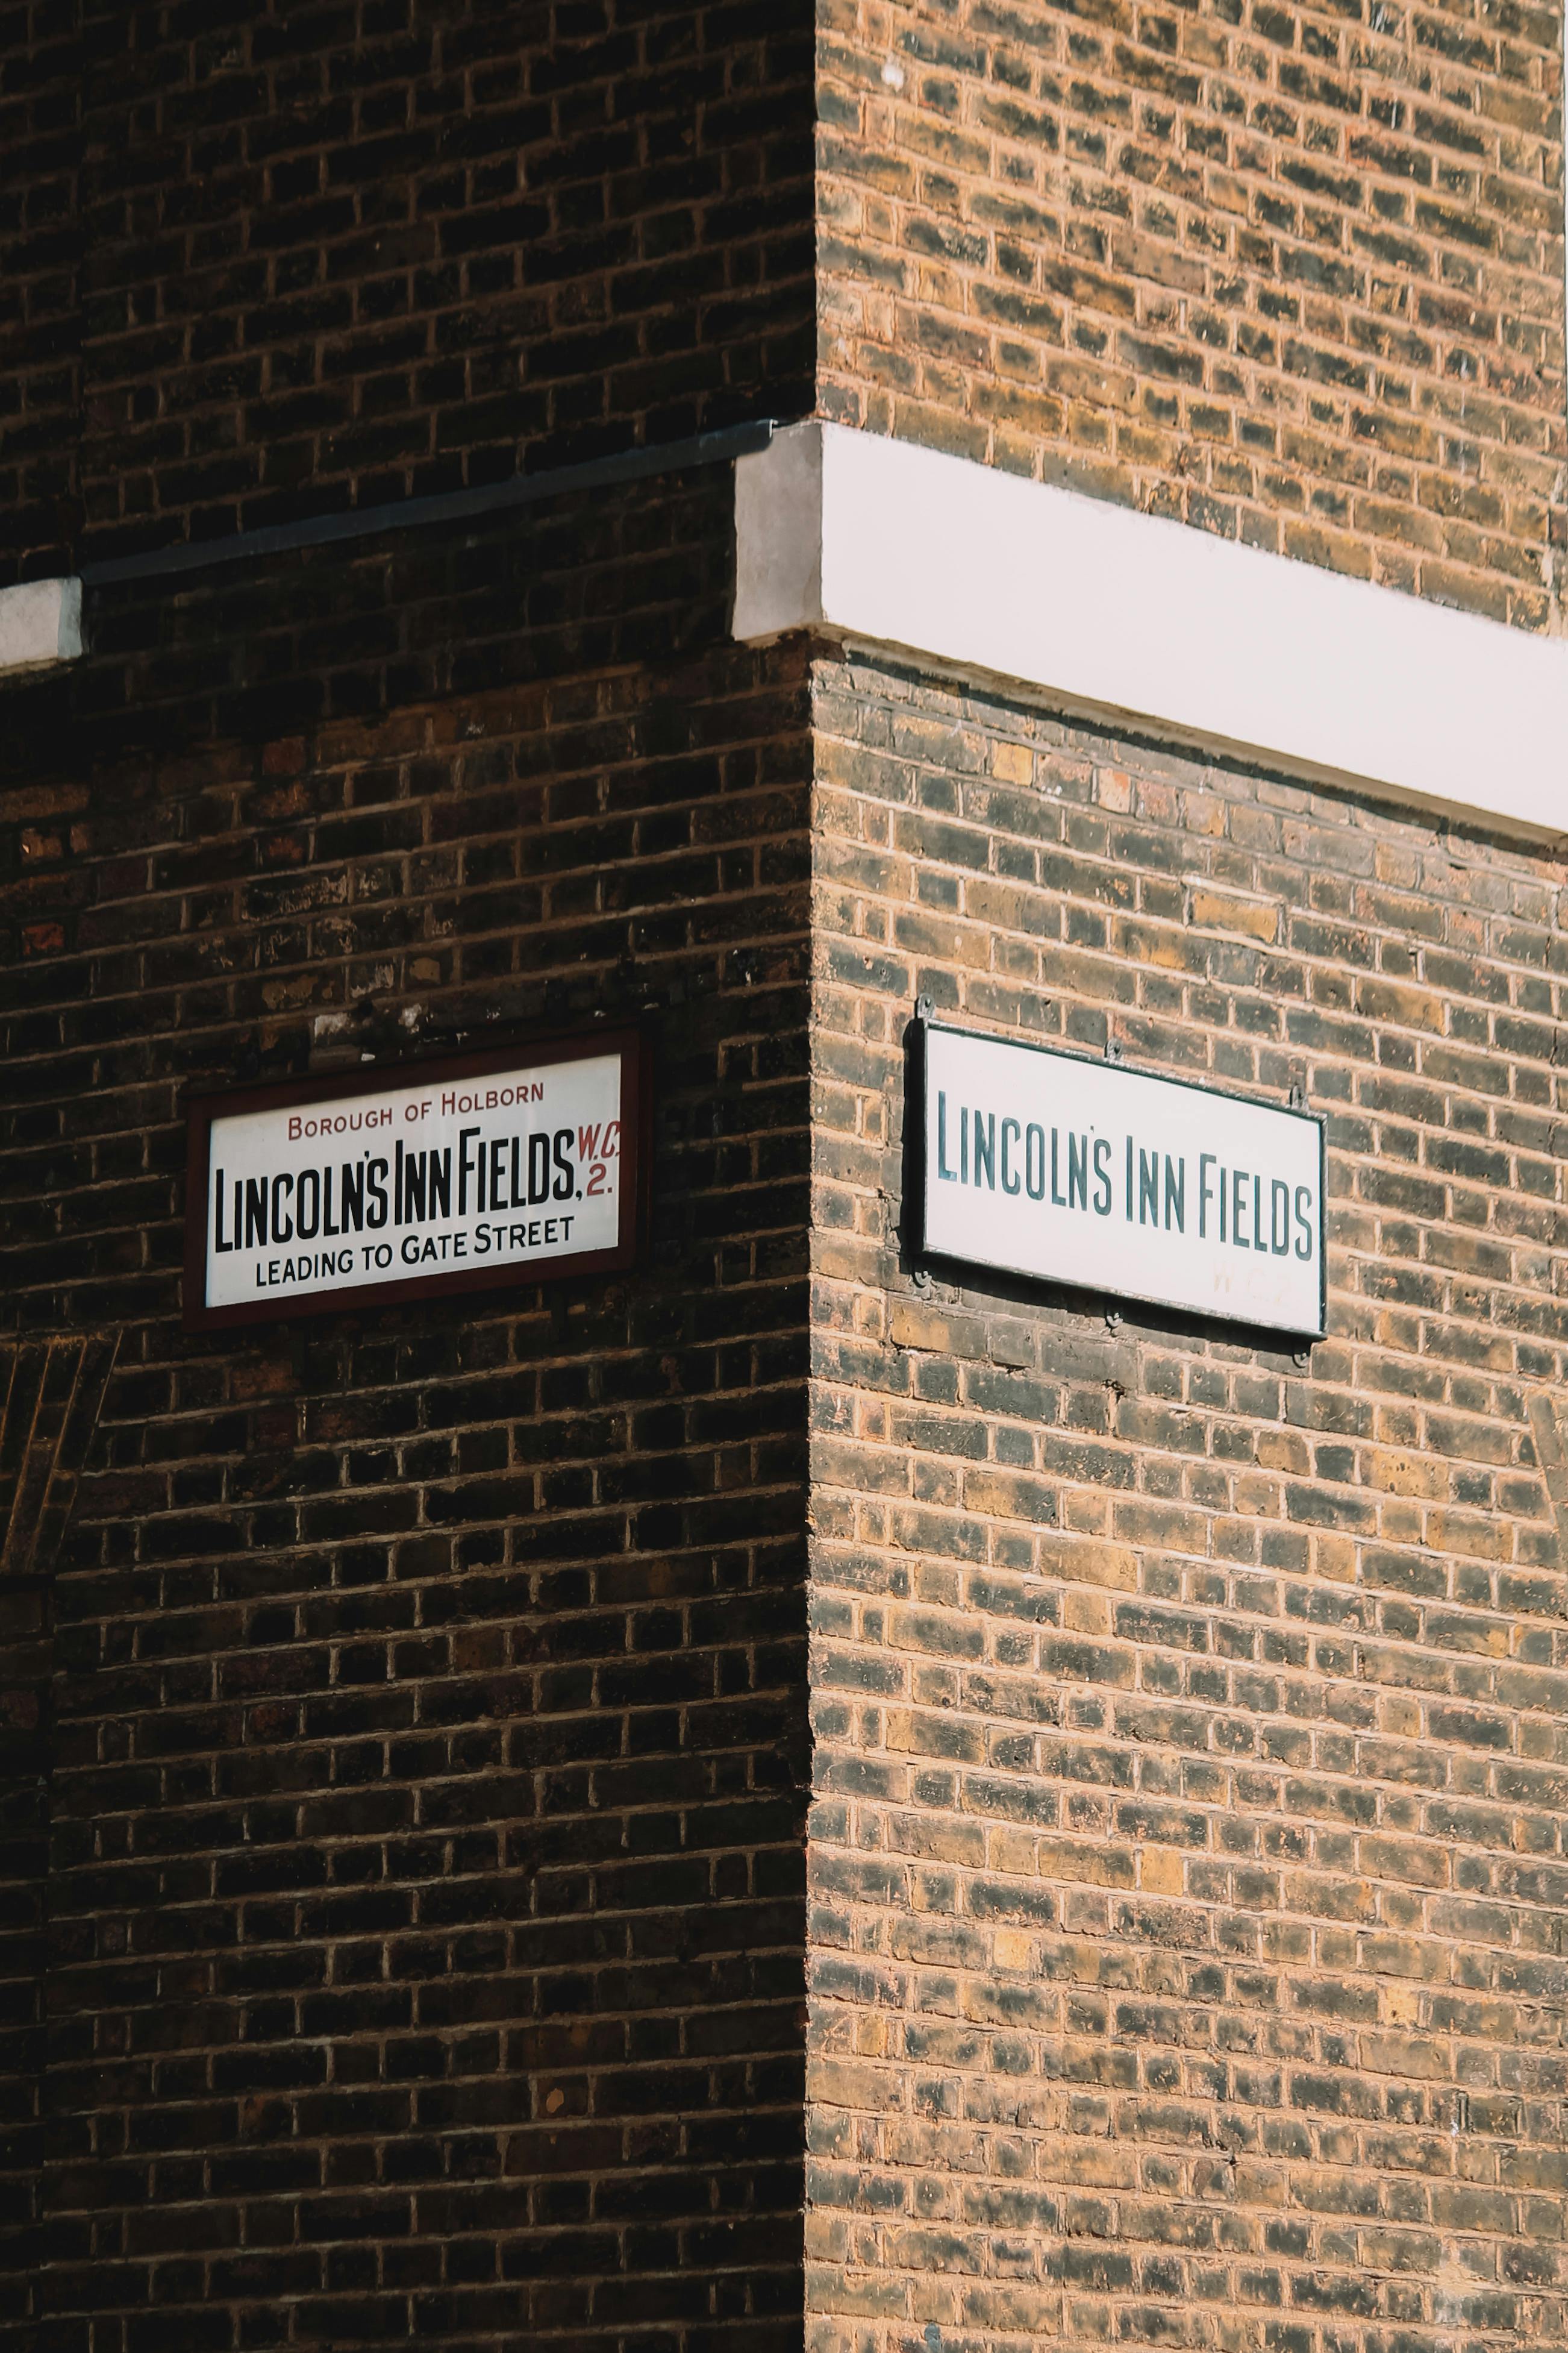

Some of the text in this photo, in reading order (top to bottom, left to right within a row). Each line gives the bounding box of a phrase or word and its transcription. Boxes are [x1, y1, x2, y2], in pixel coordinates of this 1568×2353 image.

[288, 1082, 543, 1141] BOROUGH OF HOLBORN
[215, 1127, 583, 1253] LINCOLN'S INN FIELDS,
[587, 1163, 613, 1197] 2.
[938, 1089, 1313, 1262] LINCOLN'S INN FIELDS
[256, 1215, 575, 1287] LEADING TO GATE STREET
